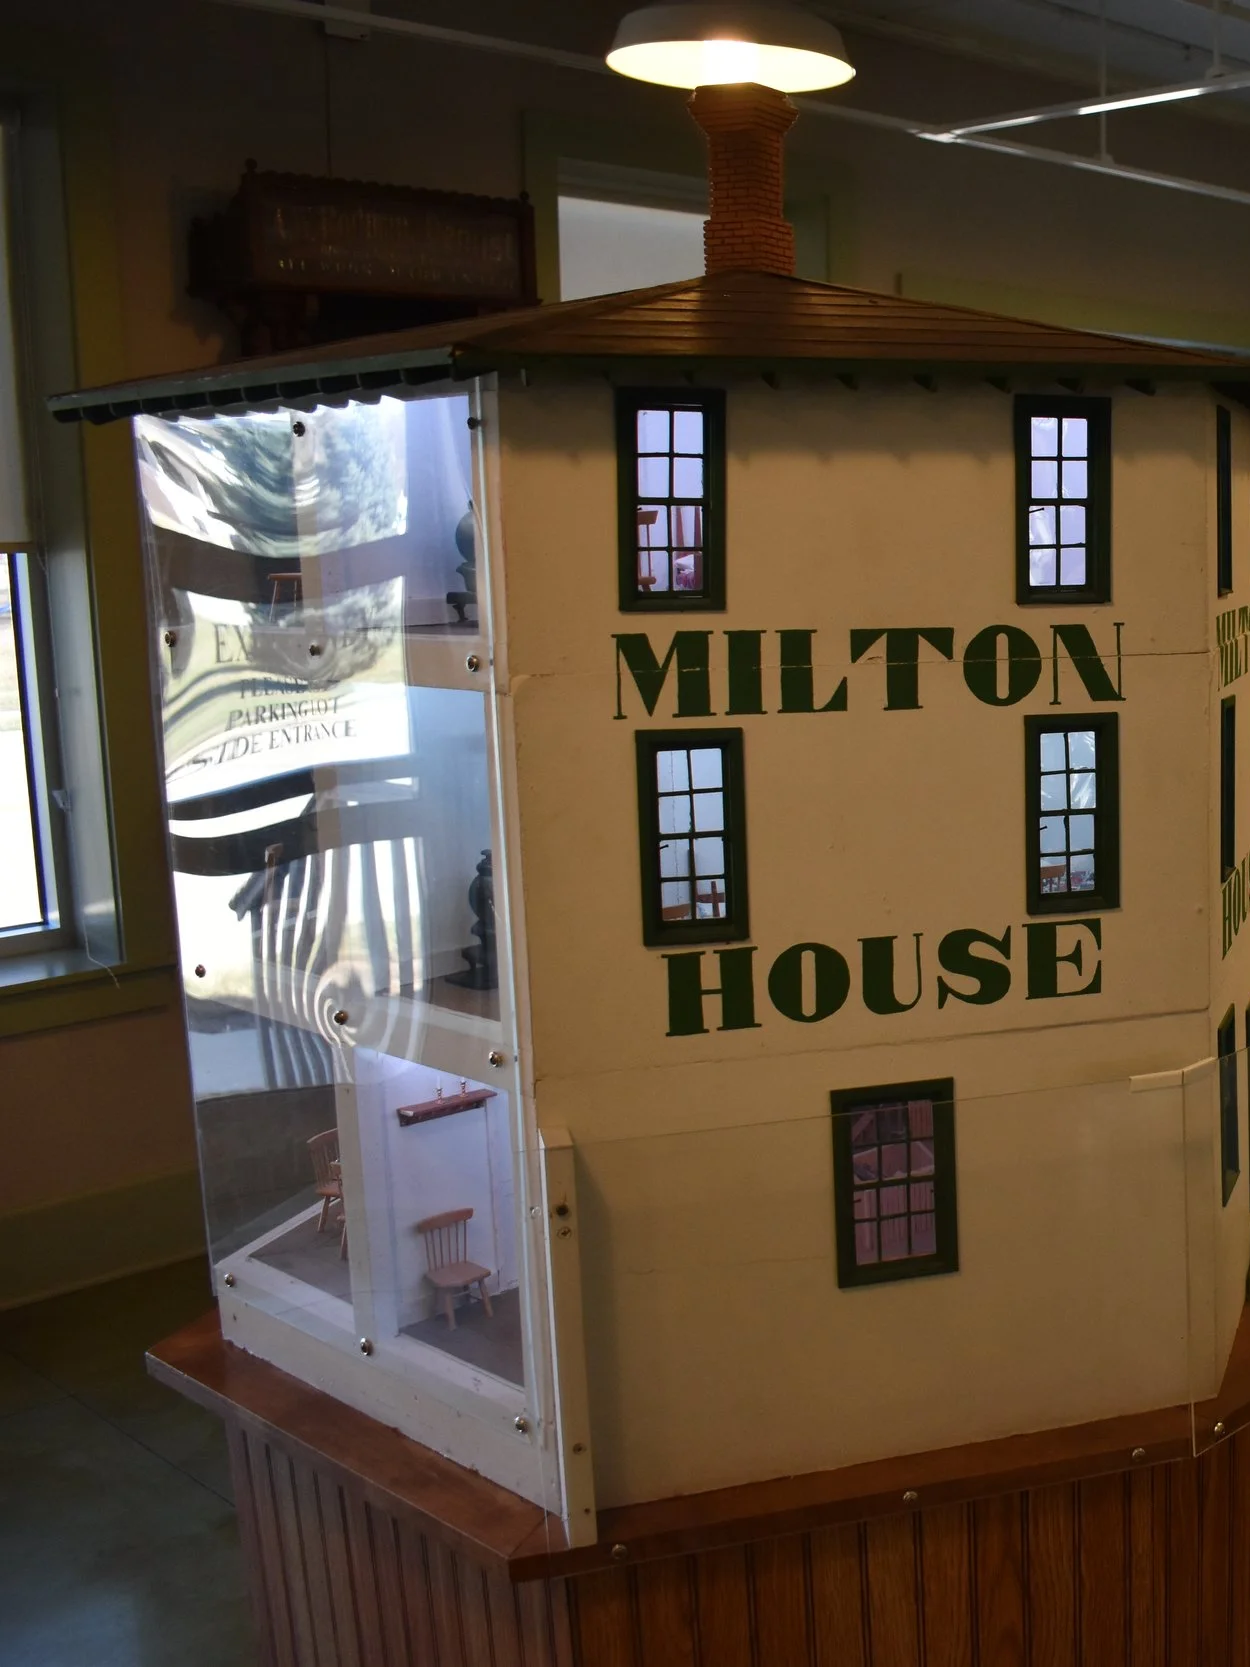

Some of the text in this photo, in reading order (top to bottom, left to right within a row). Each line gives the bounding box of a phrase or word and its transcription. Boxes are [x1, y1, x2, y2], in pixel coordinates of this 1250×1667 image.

[612, 622, 1126, 720] MILTON
[225, 700, 310, 731] PARKING
[269, 720, 358, 750] ENTRANCE
[661, 917, 1102, 1037] HOUSE
